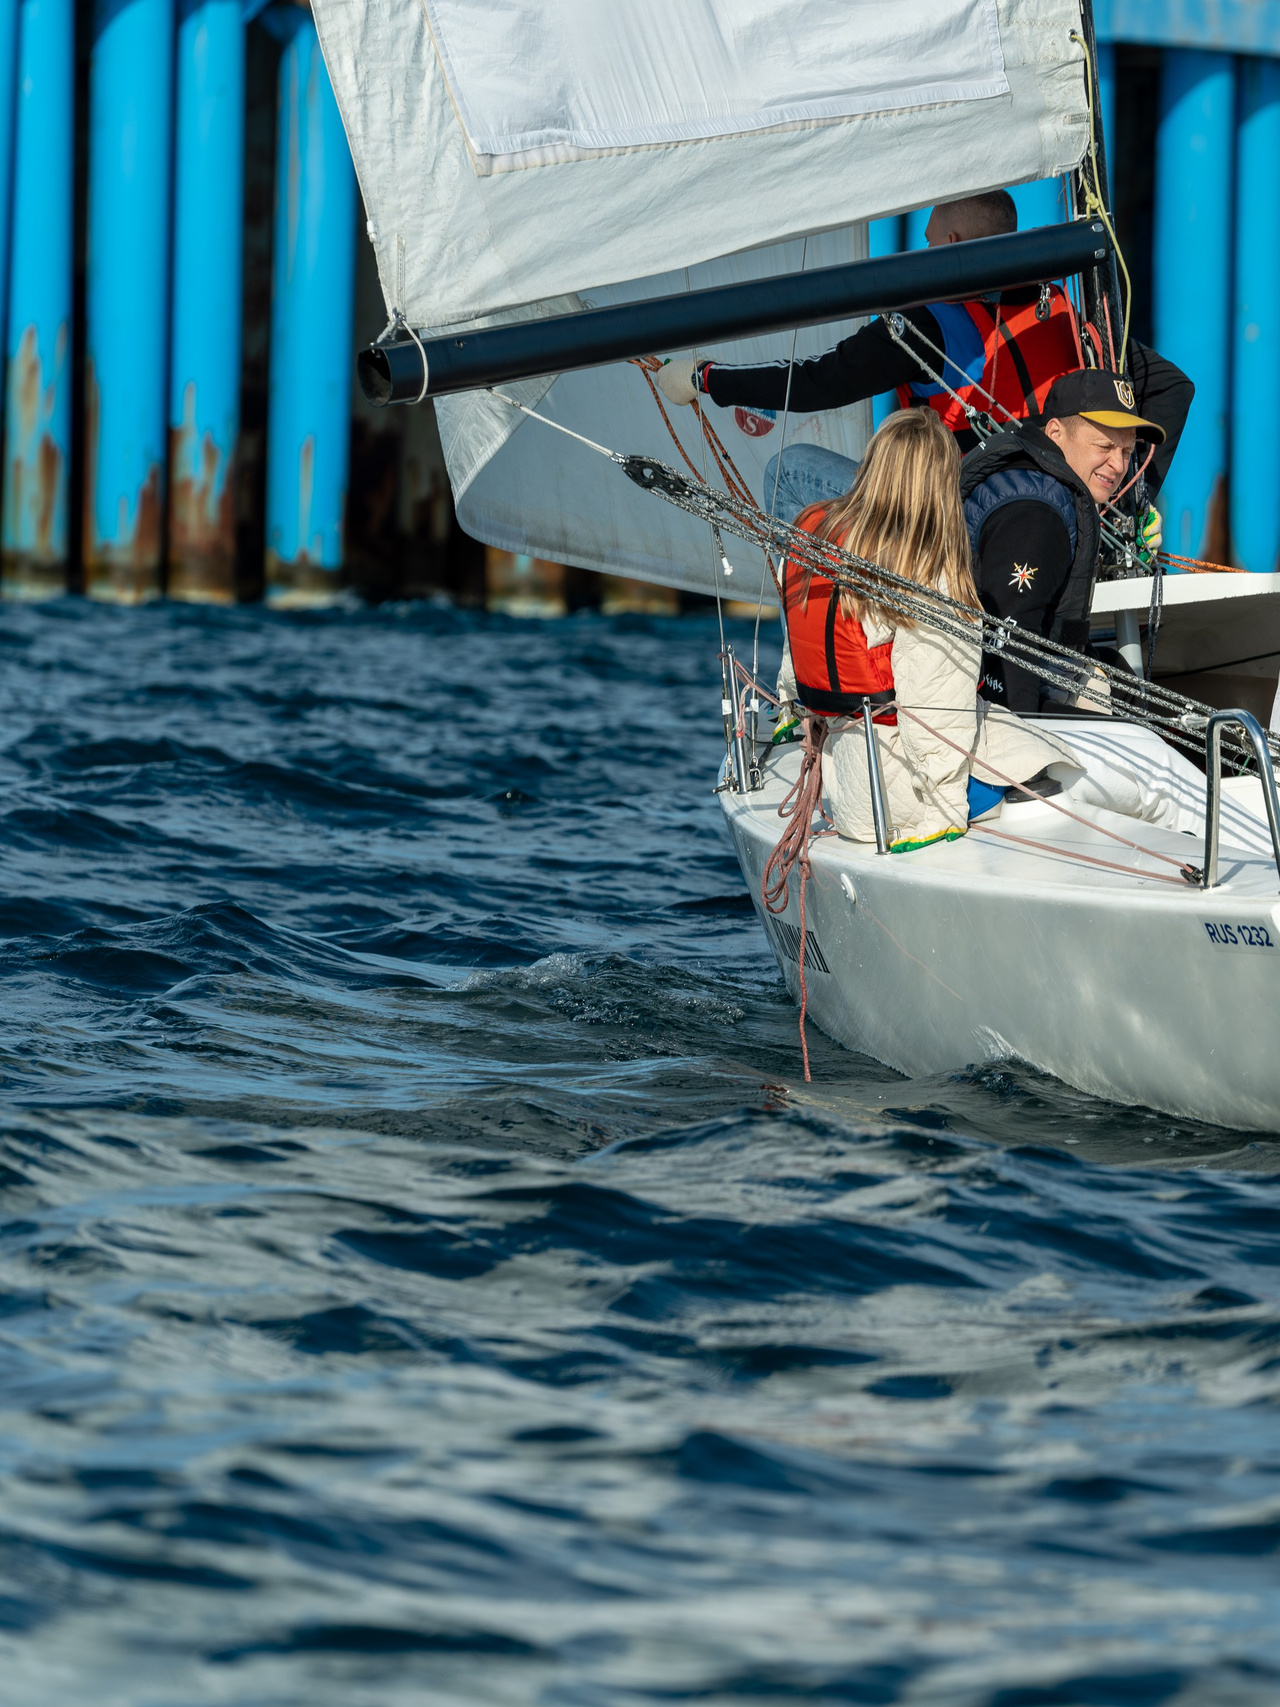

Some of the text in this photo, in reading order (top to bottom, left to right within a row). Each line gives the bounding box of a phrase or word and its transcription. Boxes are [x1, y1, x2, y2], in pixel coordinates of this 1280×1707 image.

[743, 415, 759, 434] S
[1204, 922, 1274, 948] RUS 1232
